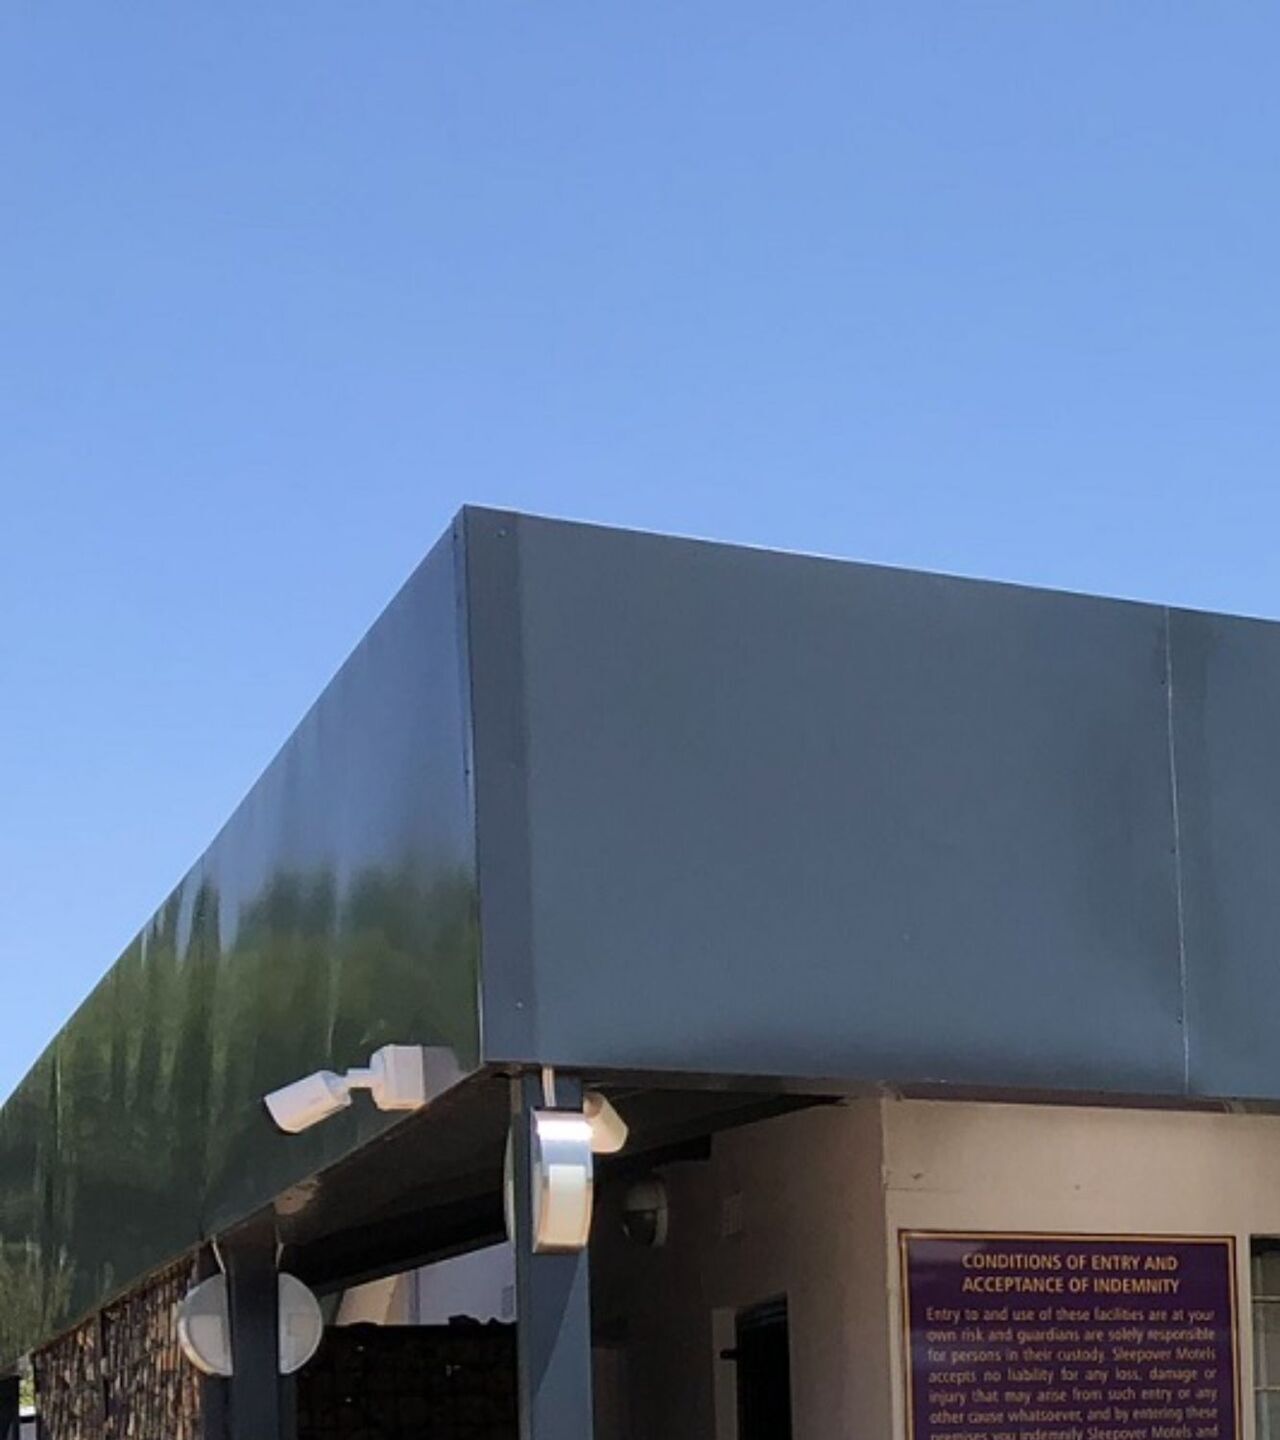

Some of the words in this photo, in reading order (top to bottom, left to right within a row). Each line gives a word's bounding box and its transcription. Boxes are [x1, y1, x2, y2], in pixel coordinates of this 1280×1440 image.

[962, 1254, 1061, 1270] CONDITIONS
[1067, 1255, 1087, 1270] OF
[1092, 1255, 1140, 1270] ENTRY
[1145, 1256, 1178, 1271] AND
[962, 1277, 1064, 1292] ACCEPTANCE
[1070, 1278, 1088, 1292] OF
[1094, 1279, 1180, 1293] INDEMNITY
[926, 1307, 960, 1324] Entry
[964, 1309, 979, 1320] to
[983, 1307, 1008, 1320] and
[1012, 1310, 1034, 1320] use
[1039, 1307, 1052, 1320] of
[1056, 1307, 1090, 1320] these
[1094, 1307, 1144, 1321] facilities
[1149, 1310, 1167, 1320] are
[1172, 1309, 1184, 1320] at
[1188, 1311, 1215, 1325] your
[926, 1331, 956, 1342] own
[961, 1328, 983, 1342] risk
[988, 1328, 1013, 1341] and
[1017, 1328, 1080, 1345] guardians
[1084, 1331, 1104, 1341] are
[1108, 1328, 1143, 1344] solely
[1147, 1328, 1215, 1344] responsible
[928, 1348, 946, 1362] for
[951, 1351, 1001, 1365] persons
[1022, 1347, 1053, 1361] their
[1112, 1347, 1171, 1363] Sleepover
[928, 1371, 976, 1385] accepts
[984, 1371, 1001, 1382] no
[1007, 1367, 1054, 1384] liability
[1061, 1366, 1078, 1381] for
[1085, 1370, 1109, 1384] any
[1149, 1366, 1197, 1383] damage
[1204, 1370, 1217, 1380] or
[972, 1389, 998, 1402] that
[1004, 1391, 1031, 1405] may
[1072, 1387, 1102, 1401] from
[1108, 1386, 1136, 1400] such
[1141, 1388, 1172, 1403] entry
[1178, 1389, 1190, 1399] or
[1195, 1389, 1217, 1402] any
[929, 1409, 964, 1424] other
[967, 1412, 1003, 1424] cause
[1087, 1407, 1111, 1421] and
[1113, 1406, 1129, 1423] by
[1151, 1424, 1192, 1439] Motels
[1195, 1423, 1218, 1438] and
